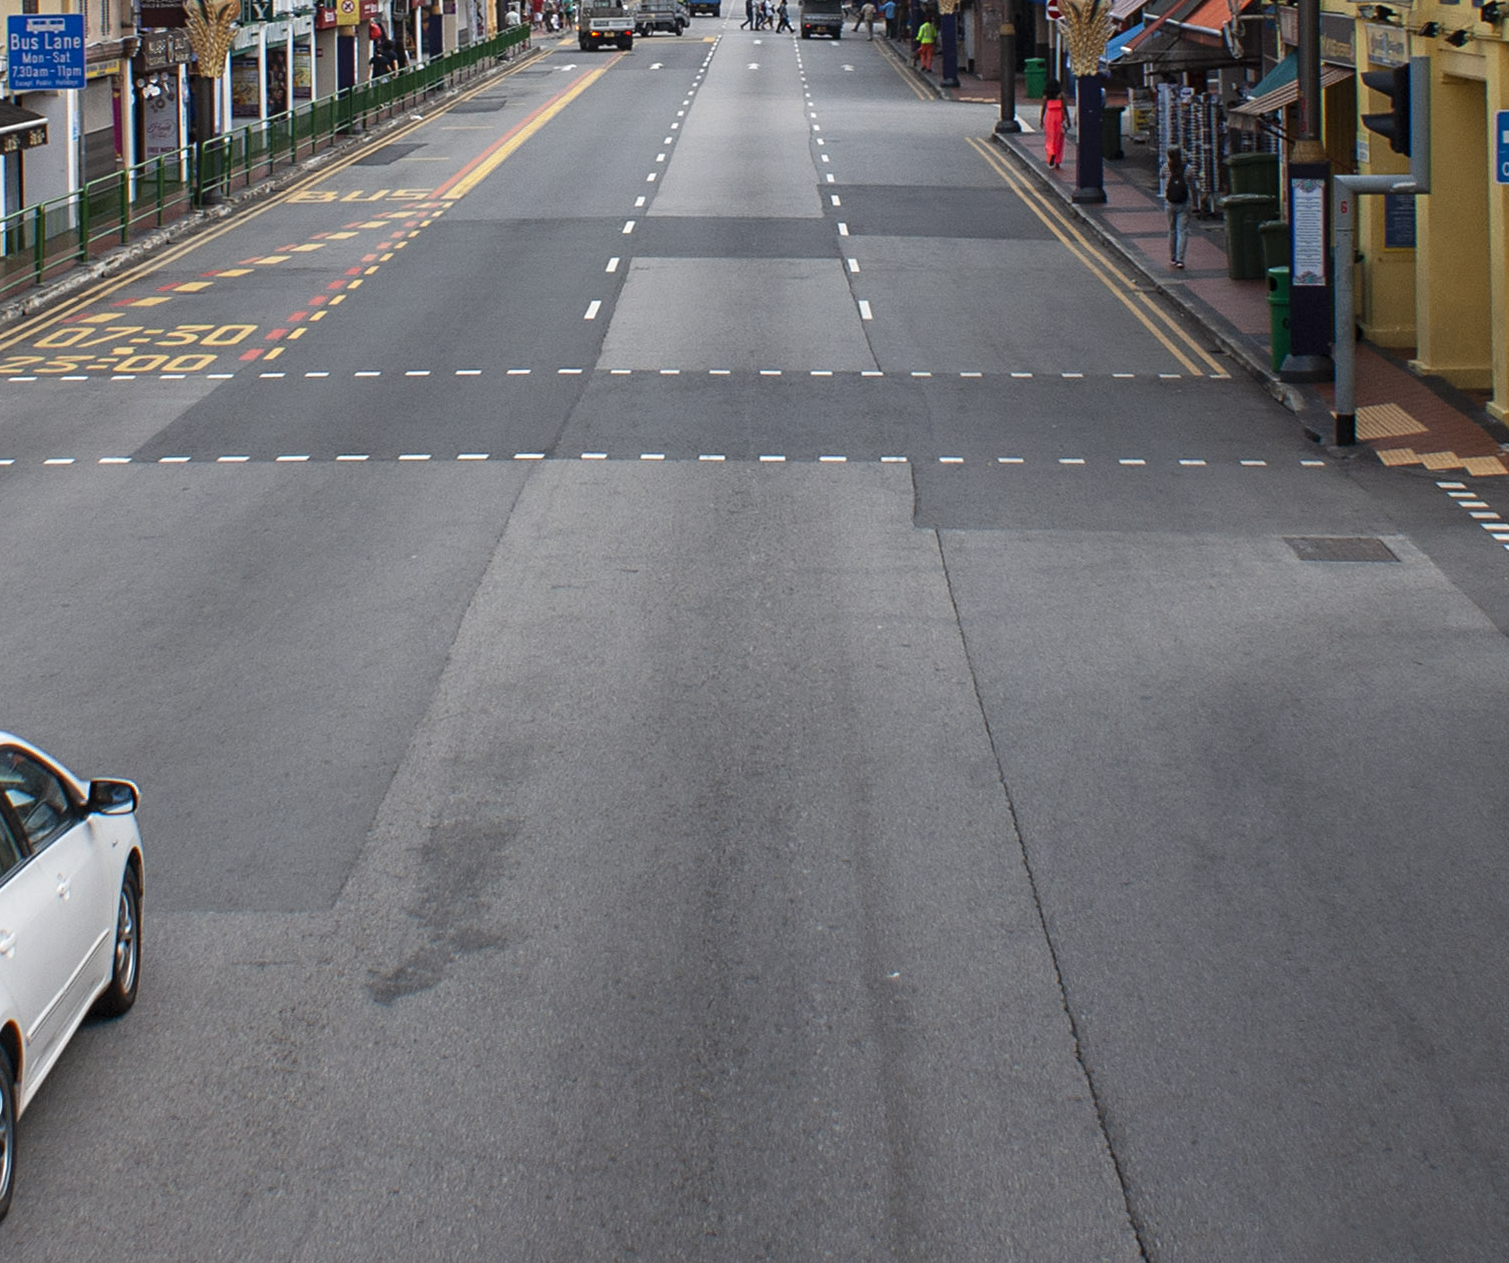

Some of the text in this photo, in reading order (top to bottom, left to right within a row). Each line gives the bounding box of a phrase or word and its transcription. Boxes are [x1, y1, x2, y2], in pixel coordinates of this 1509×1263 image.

[10, 33, 82, 50] Bus Lane
[285, 188, 434, 203] BUS
